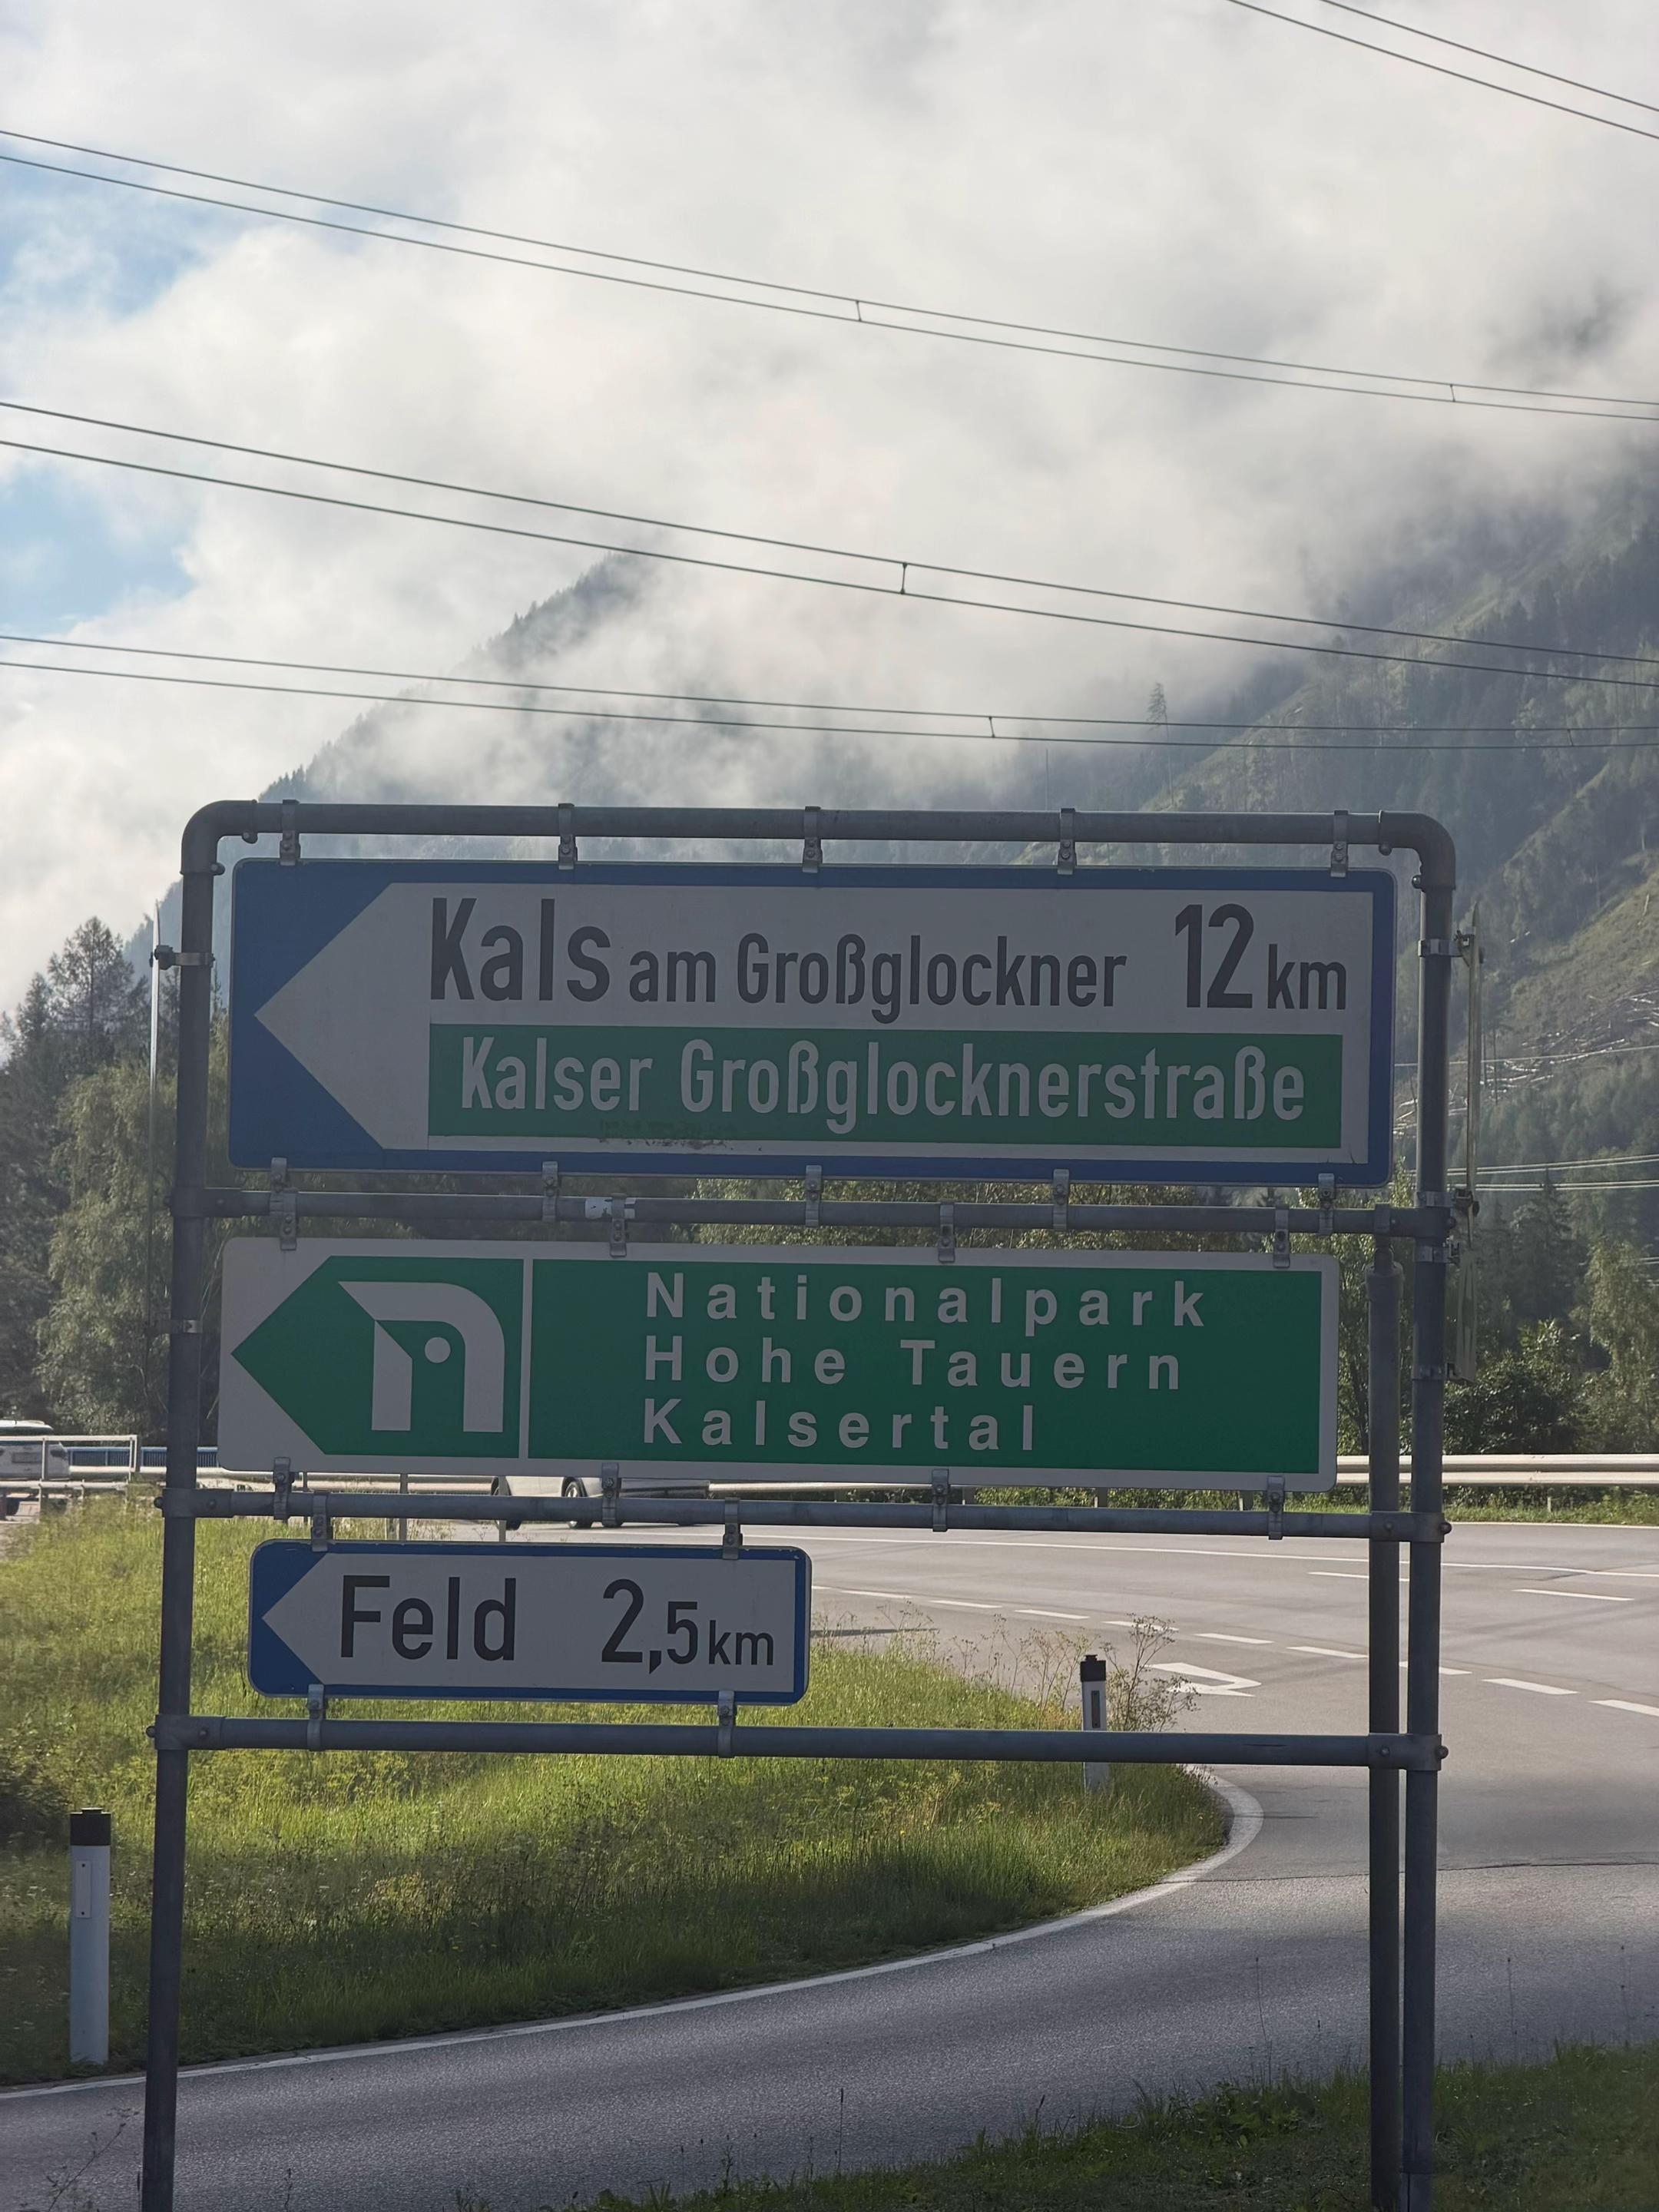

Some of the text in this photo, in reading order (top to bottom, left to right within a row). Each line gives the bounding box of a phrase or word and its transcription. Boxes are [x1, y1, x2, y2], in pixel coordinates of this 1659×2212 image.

[430, 897, 1346, 1024] Kals am Großglockner 12 km
[461, 1036, 1305, 1134] Kalser Großglocknerstraße
[646, 1271, 1205, 1336] Nationalpark
[644, 1335, 1181, 1390] Hohe Tauern
[644, 1398, 1034, 1452] Kalsertal
[340, 1575, 774, 1674] Feld 2,5 km
